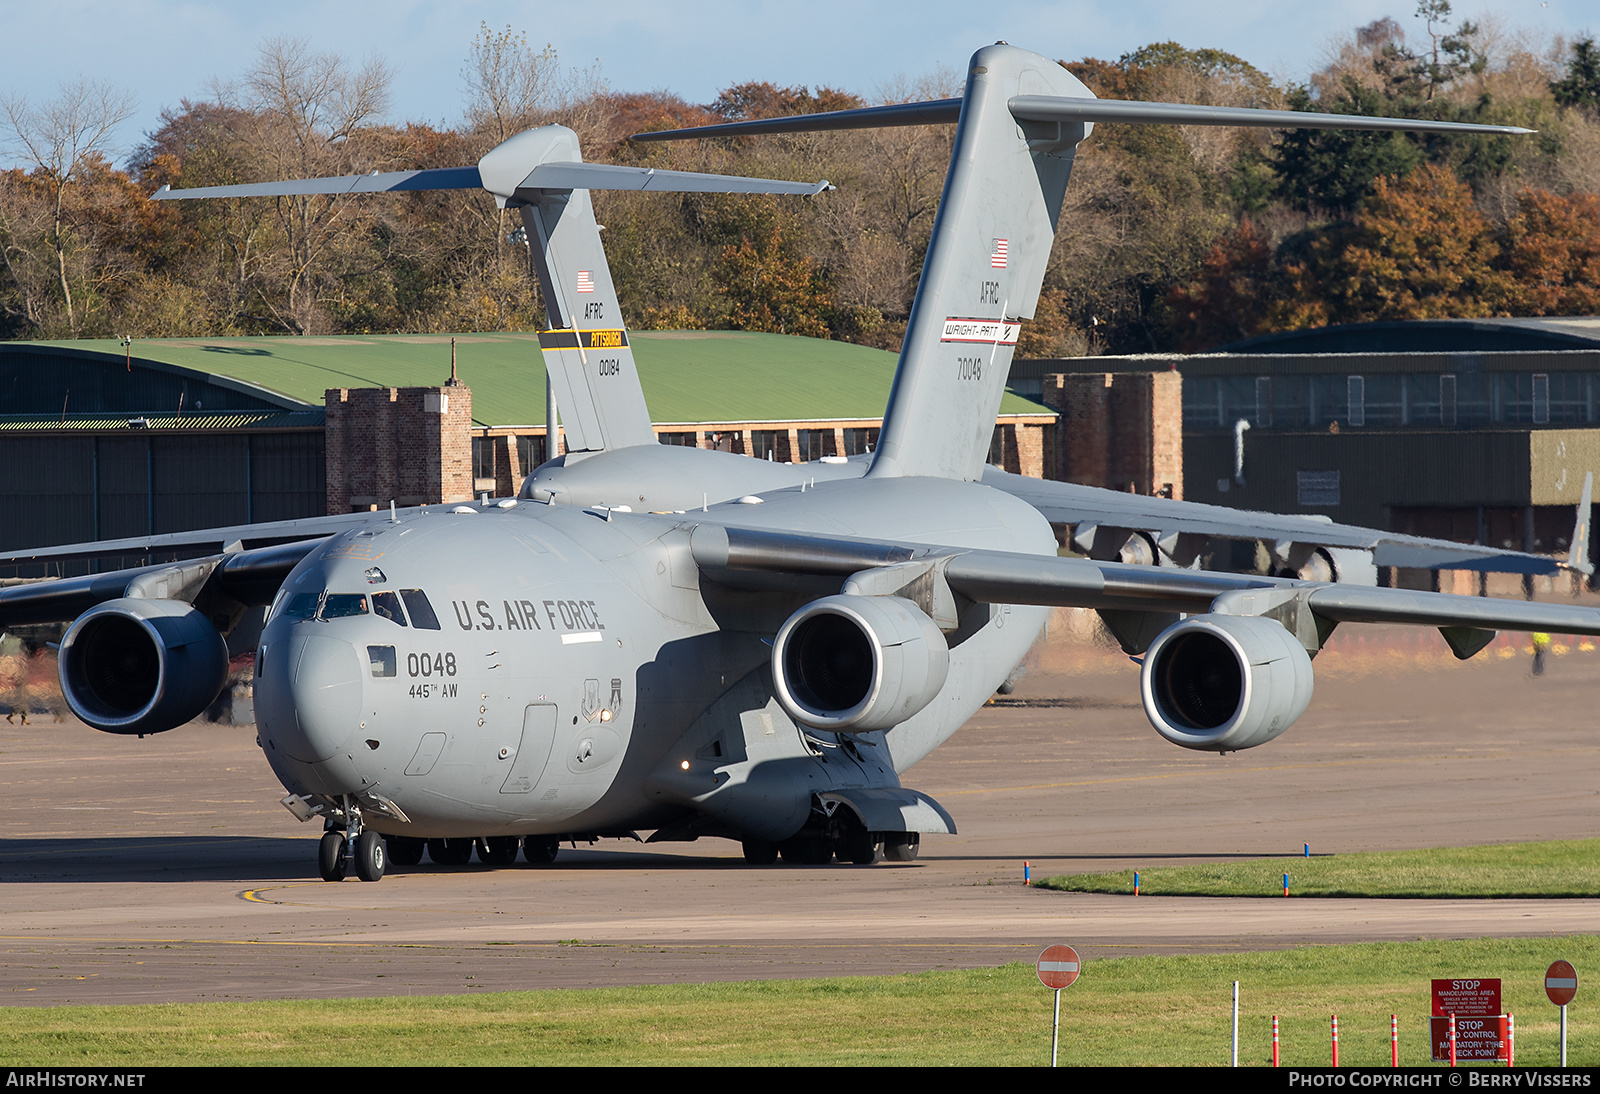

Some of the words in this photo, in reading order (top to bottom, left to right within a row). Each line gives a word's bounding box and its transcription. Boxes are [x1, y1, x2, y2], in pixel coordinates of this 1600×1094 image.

[981, 281, 1000, 304] AFRC
[584, 303, 603, 319] AFRC
[945, 324, 998, 337] WRIGHT-PATT
[599, 359, 620, 376] 00184
[957, 357, 982, 380] 70048
[452, 600, 502, 631] U.S.
[503, 600, 542, 630] AIR
[543, 600, 606, 630] FORCE
[407, 652, 457, 677] 0048
[408, 684, 438, 698] 445TH
[442, 684, 458, 698] AW
[1452, 980, 1481, 990] STOP
[1459, 1021, 1484, 1030] STOP
[1463, 1031, 1498, 1039] CONTROL
[1485, 1040, 1504, 1048] TYRE
